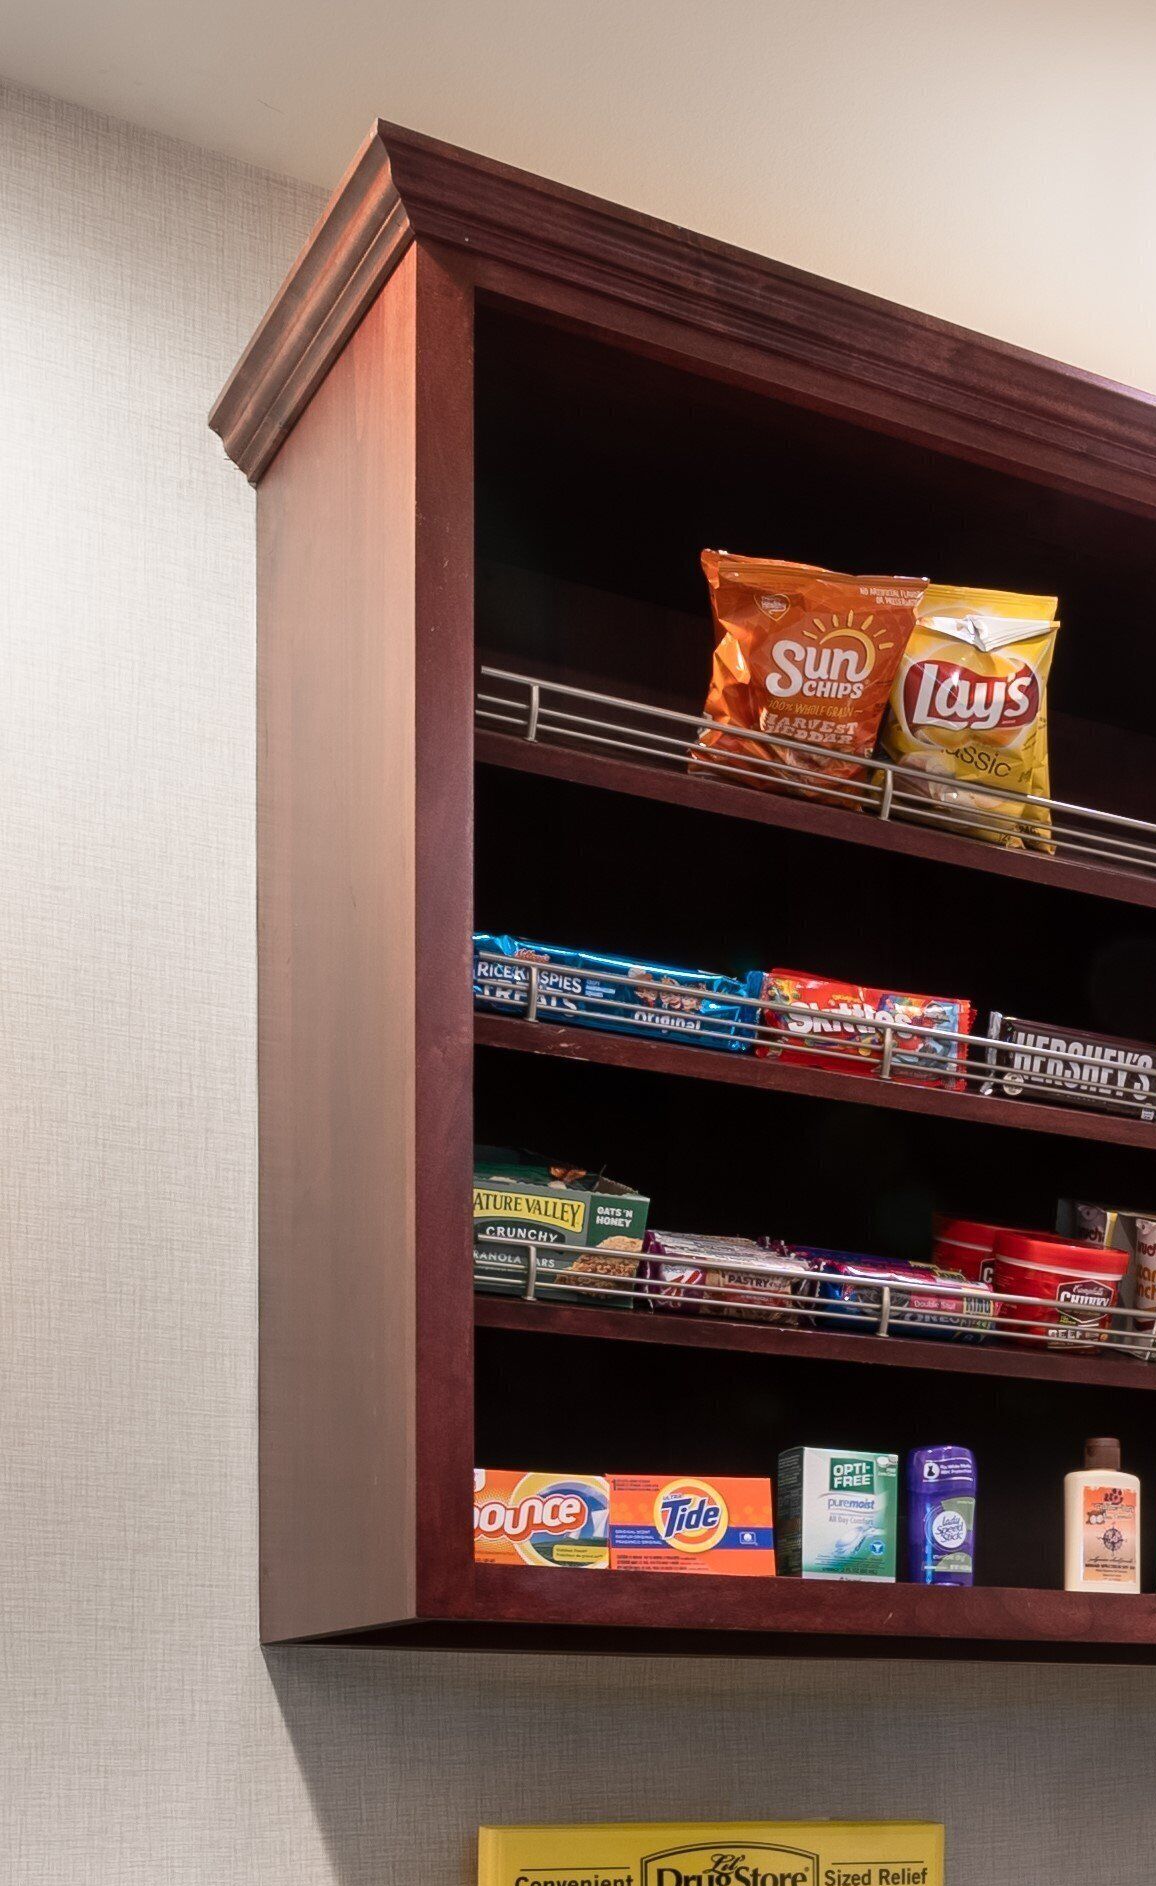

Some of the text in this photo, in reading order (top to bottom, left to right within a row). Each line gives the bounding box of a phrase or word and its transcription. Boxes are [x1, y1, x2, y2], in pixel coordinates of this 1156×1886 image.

[766, 639, 870, 698] Sun
[802, 681, 865, 700] CHIPS
[912, 662, 1033, 731] Lay's
[795, 705, 826, 716] WHOLE
[826, 706, 854, 719] GRAIN
[477, 962, 515, 979] RICE
[788, 1001, 913, 1040] Skittles
[1012, 1031, 1153, 1101] HERSHEY'S
[474, 1192, 581, 1229] ATURE VALLEY
[596, 1206, 622, 1217] OATS
[595, 1215, 632, 1228] HONEY
[485, 1226, 559, 1243] CRUNCHY
[833, 1462, 871, 1477] OPTI-
[833, 1475, 871, 1489] FREE
[827, 1498, 876, 1510] puremoist
[661, 1498, 721, 1539] Tide
[878, 1866, 928, 1886] Relief
